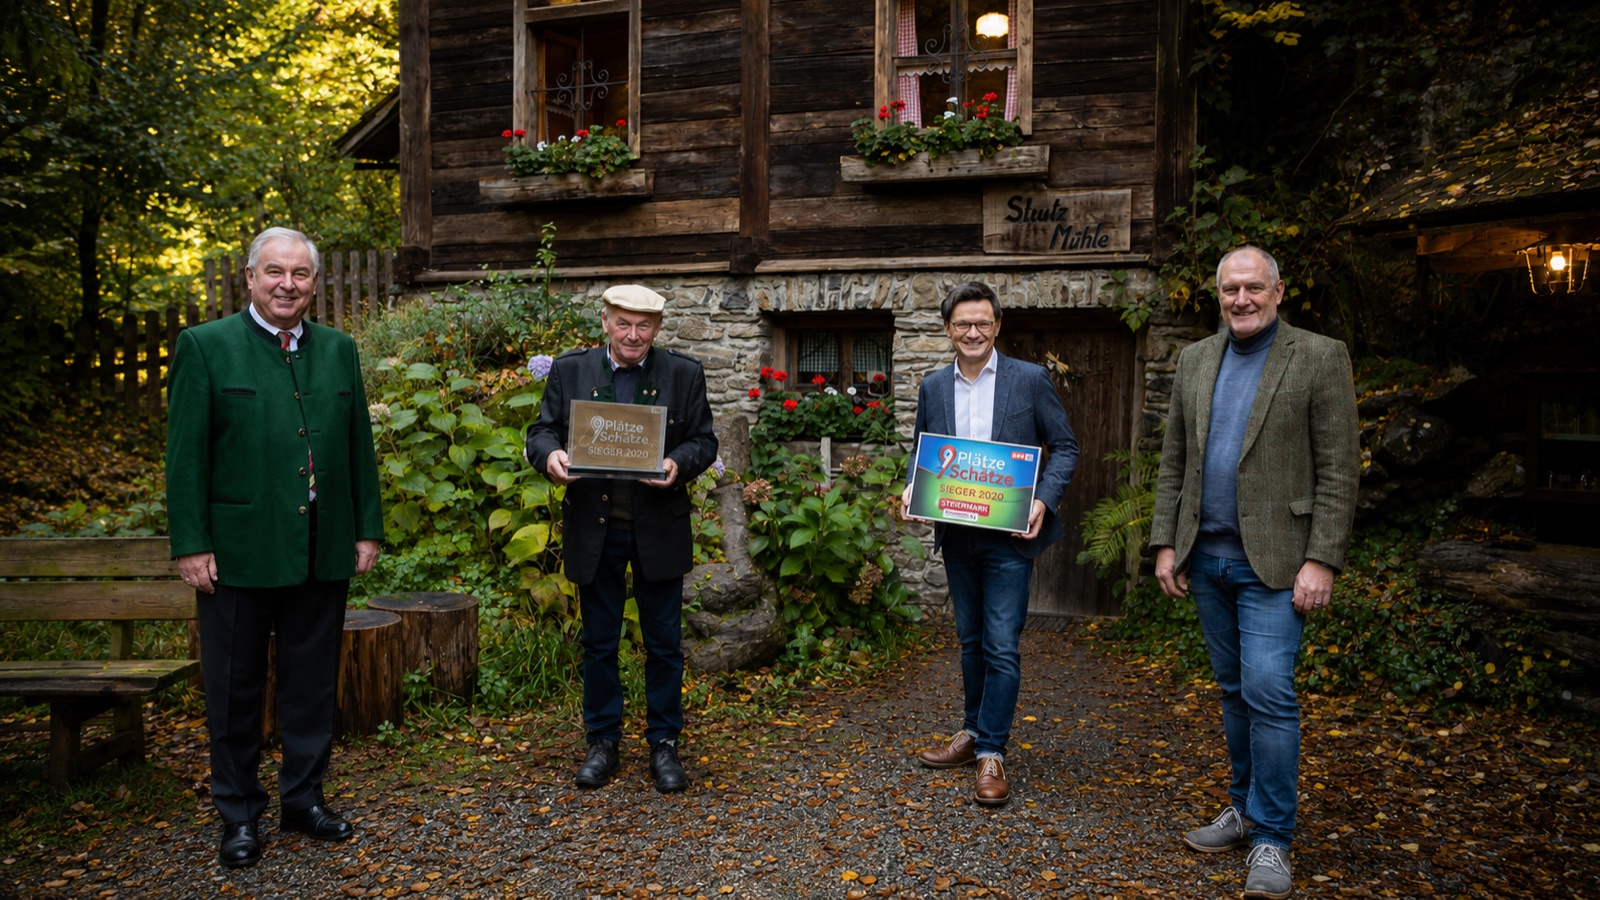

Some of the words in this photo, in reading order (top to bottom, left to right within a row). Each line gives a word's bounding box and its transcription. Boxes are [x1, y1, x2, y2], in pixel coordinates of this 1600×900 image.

[1049, 223, 1109, 250] Mühle
[588, 446, 622, 456] SIEGER
[624, 449, 648, 458] 2020
[957, 451, 1005, 470] Plätze
[949, 464, 1014, 487] Schätze
[940, 484, 976, 497] SIEGER
[978, 490, 1004, 501] 2020
[941, 500, 988, 512] STEIERMARK
